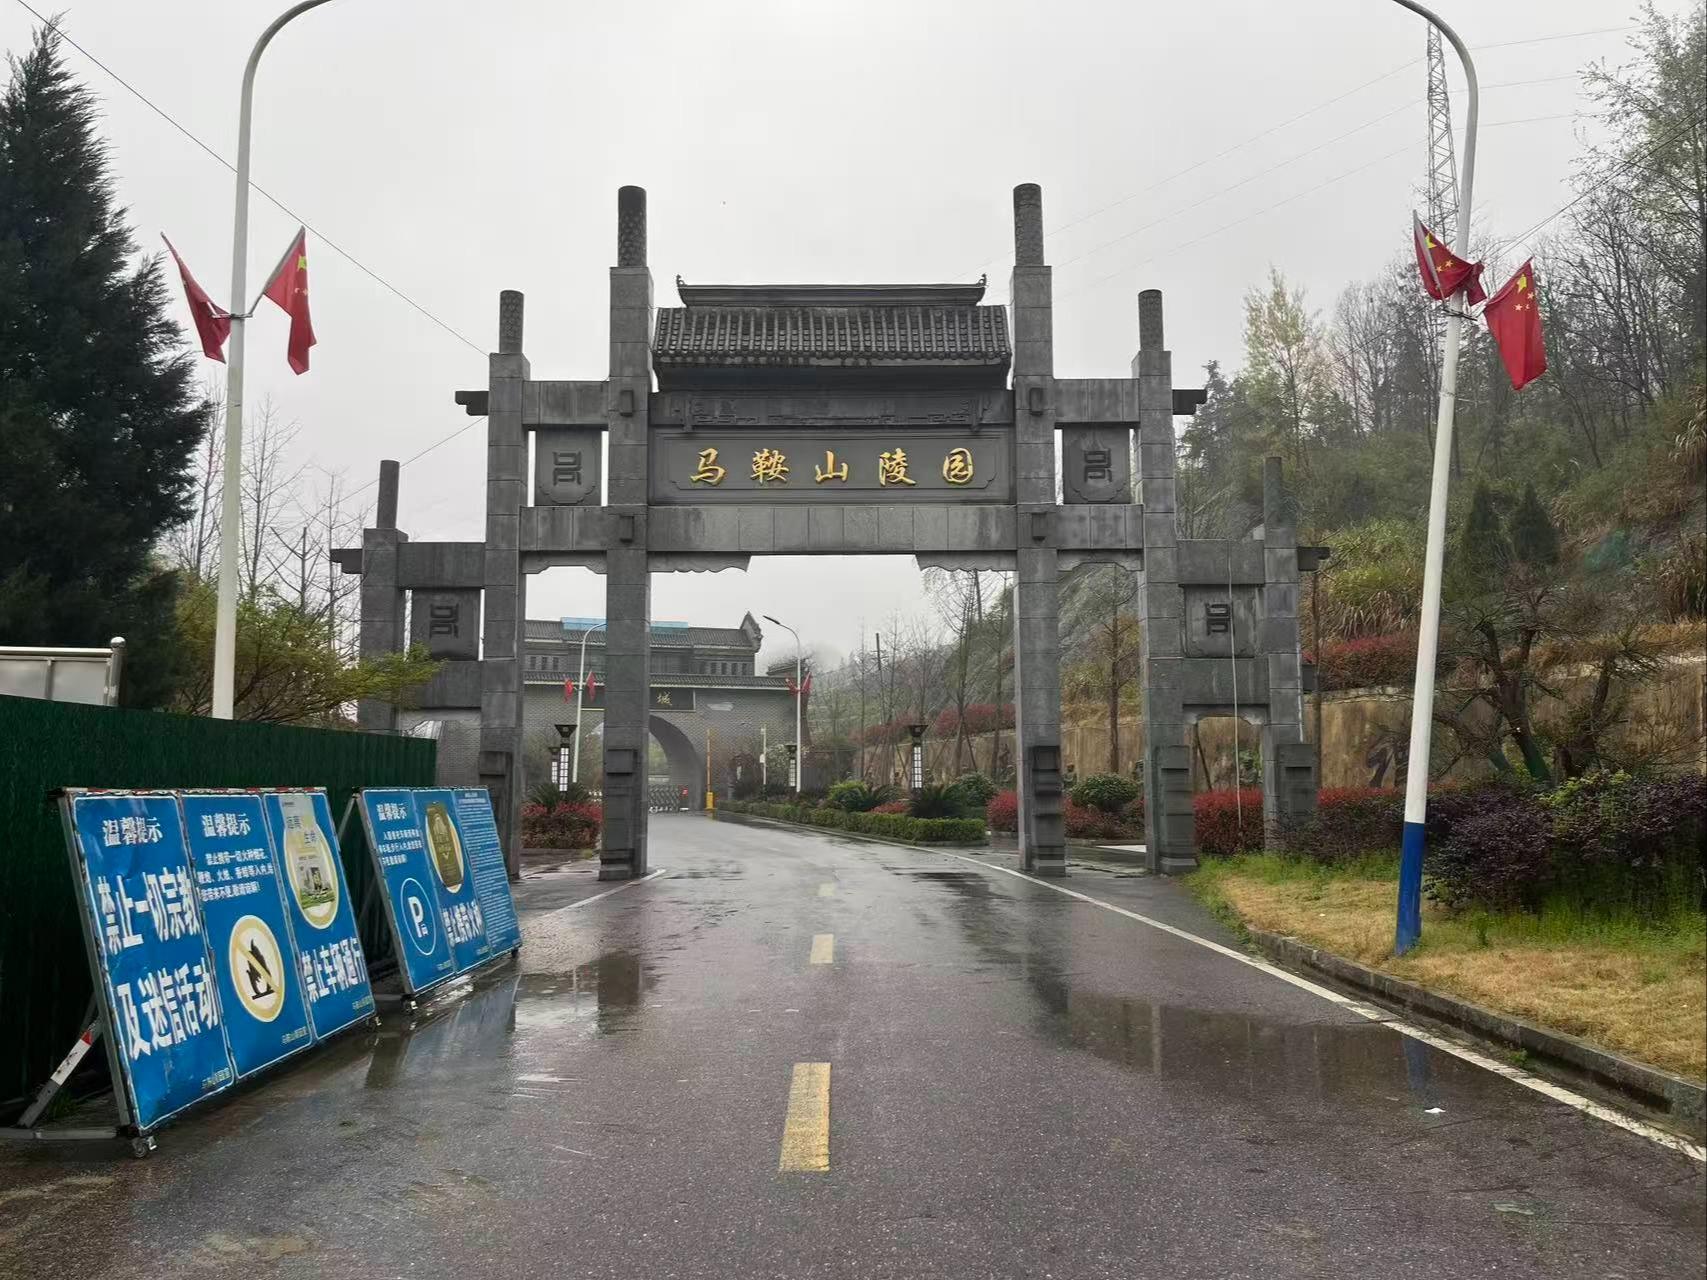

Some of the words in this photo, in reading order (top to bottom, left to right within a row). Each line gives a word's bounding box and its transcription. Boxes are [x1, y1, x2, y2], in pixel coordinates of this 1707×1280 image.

[689, 446, 975, 486] 马鞍山陵园
[102, 816, 164, 847] 温馨提示
[200, 812, 252, 838] 温馨提示
[98, 865, 201, 955] 禁止一切宗教
[301, 937, 366, 1003] 禁止车辆通行
[117, 957, 219, 1061] 及迷信活动
